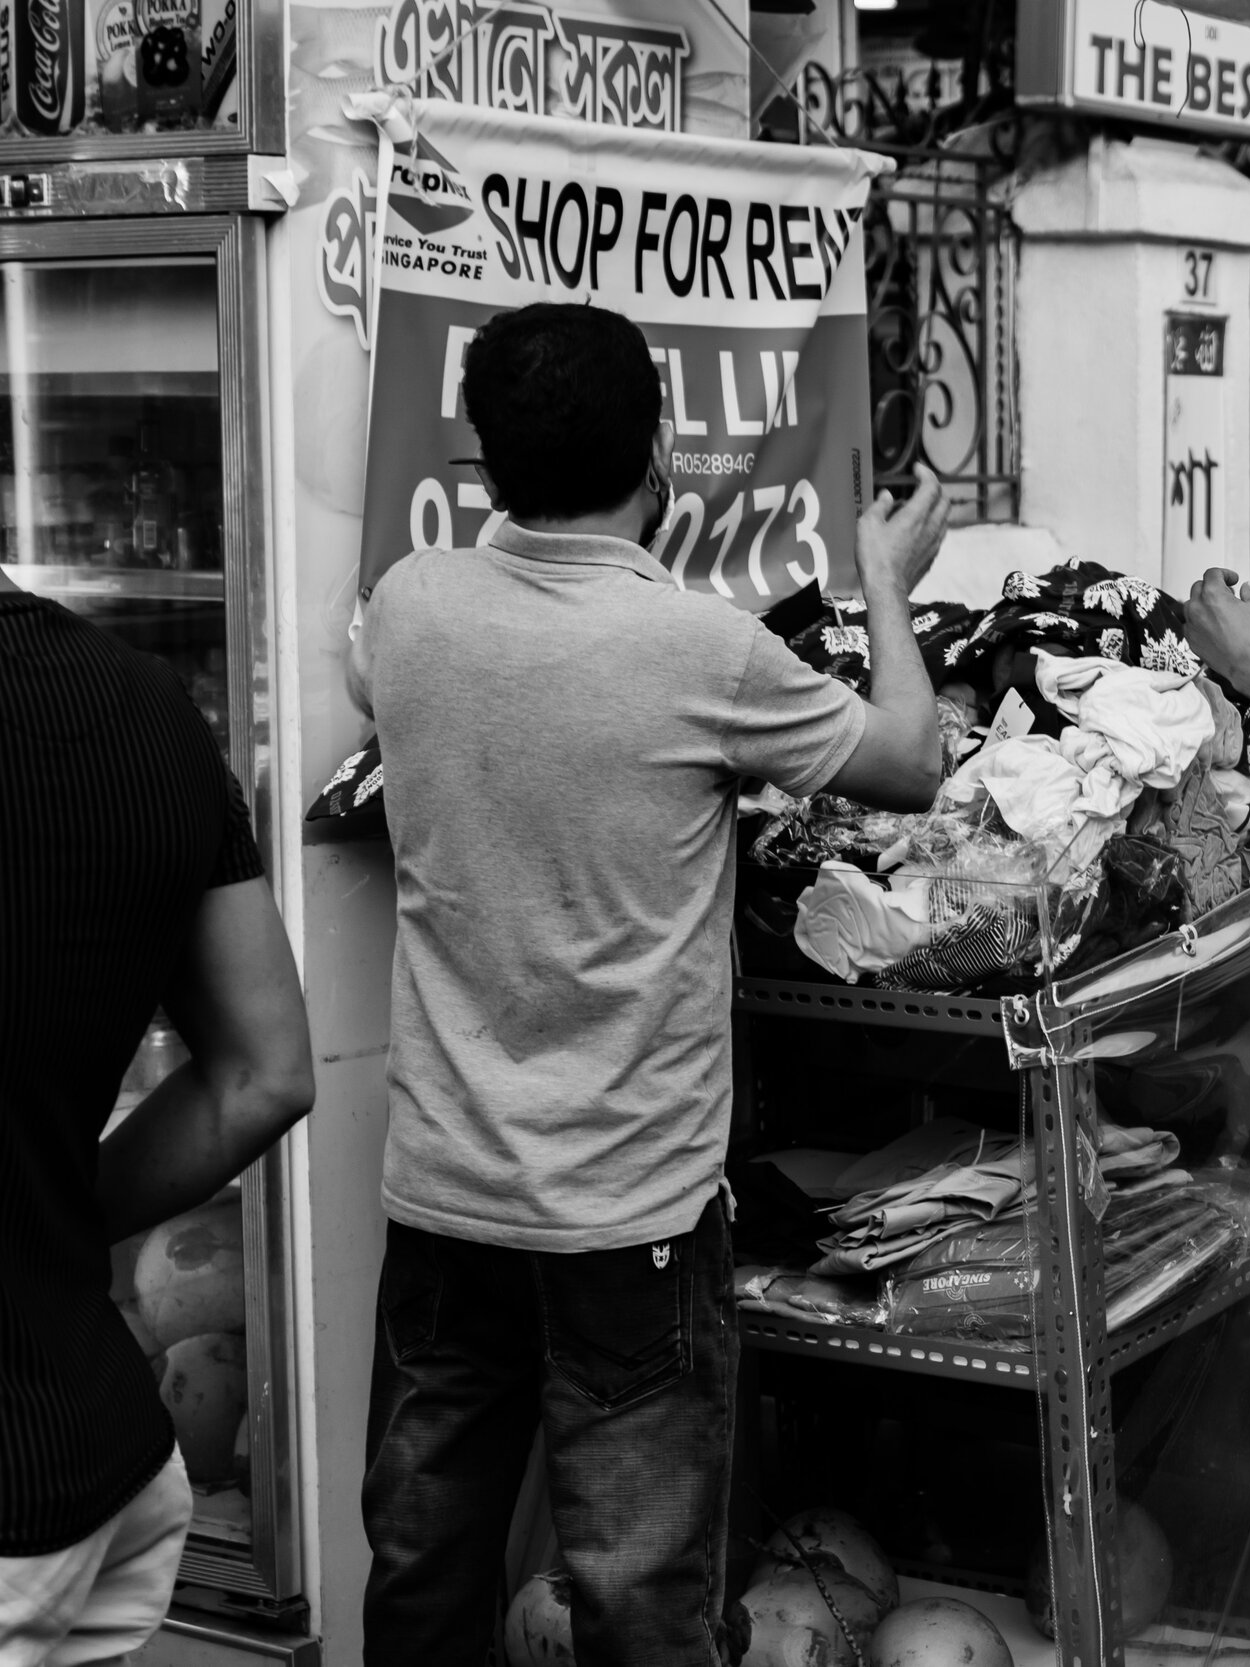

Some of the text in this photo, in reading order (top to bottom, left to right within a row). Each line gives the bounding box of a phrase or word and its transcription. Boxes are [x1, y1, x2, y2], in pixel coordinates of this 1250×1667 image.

[1090, 35, 1172, 106] THE
[418, 237, 446, 254] You
[451, 245, 487, 260] Trust
[482, 173, 624, 291] SHOP
[635, 191, 735, 299] FOR
[1184, 251, 1213, 297] 37
[672, 452, 755, 474] R052894G
[923, 1272, 993, 1291] SINGAPORE
